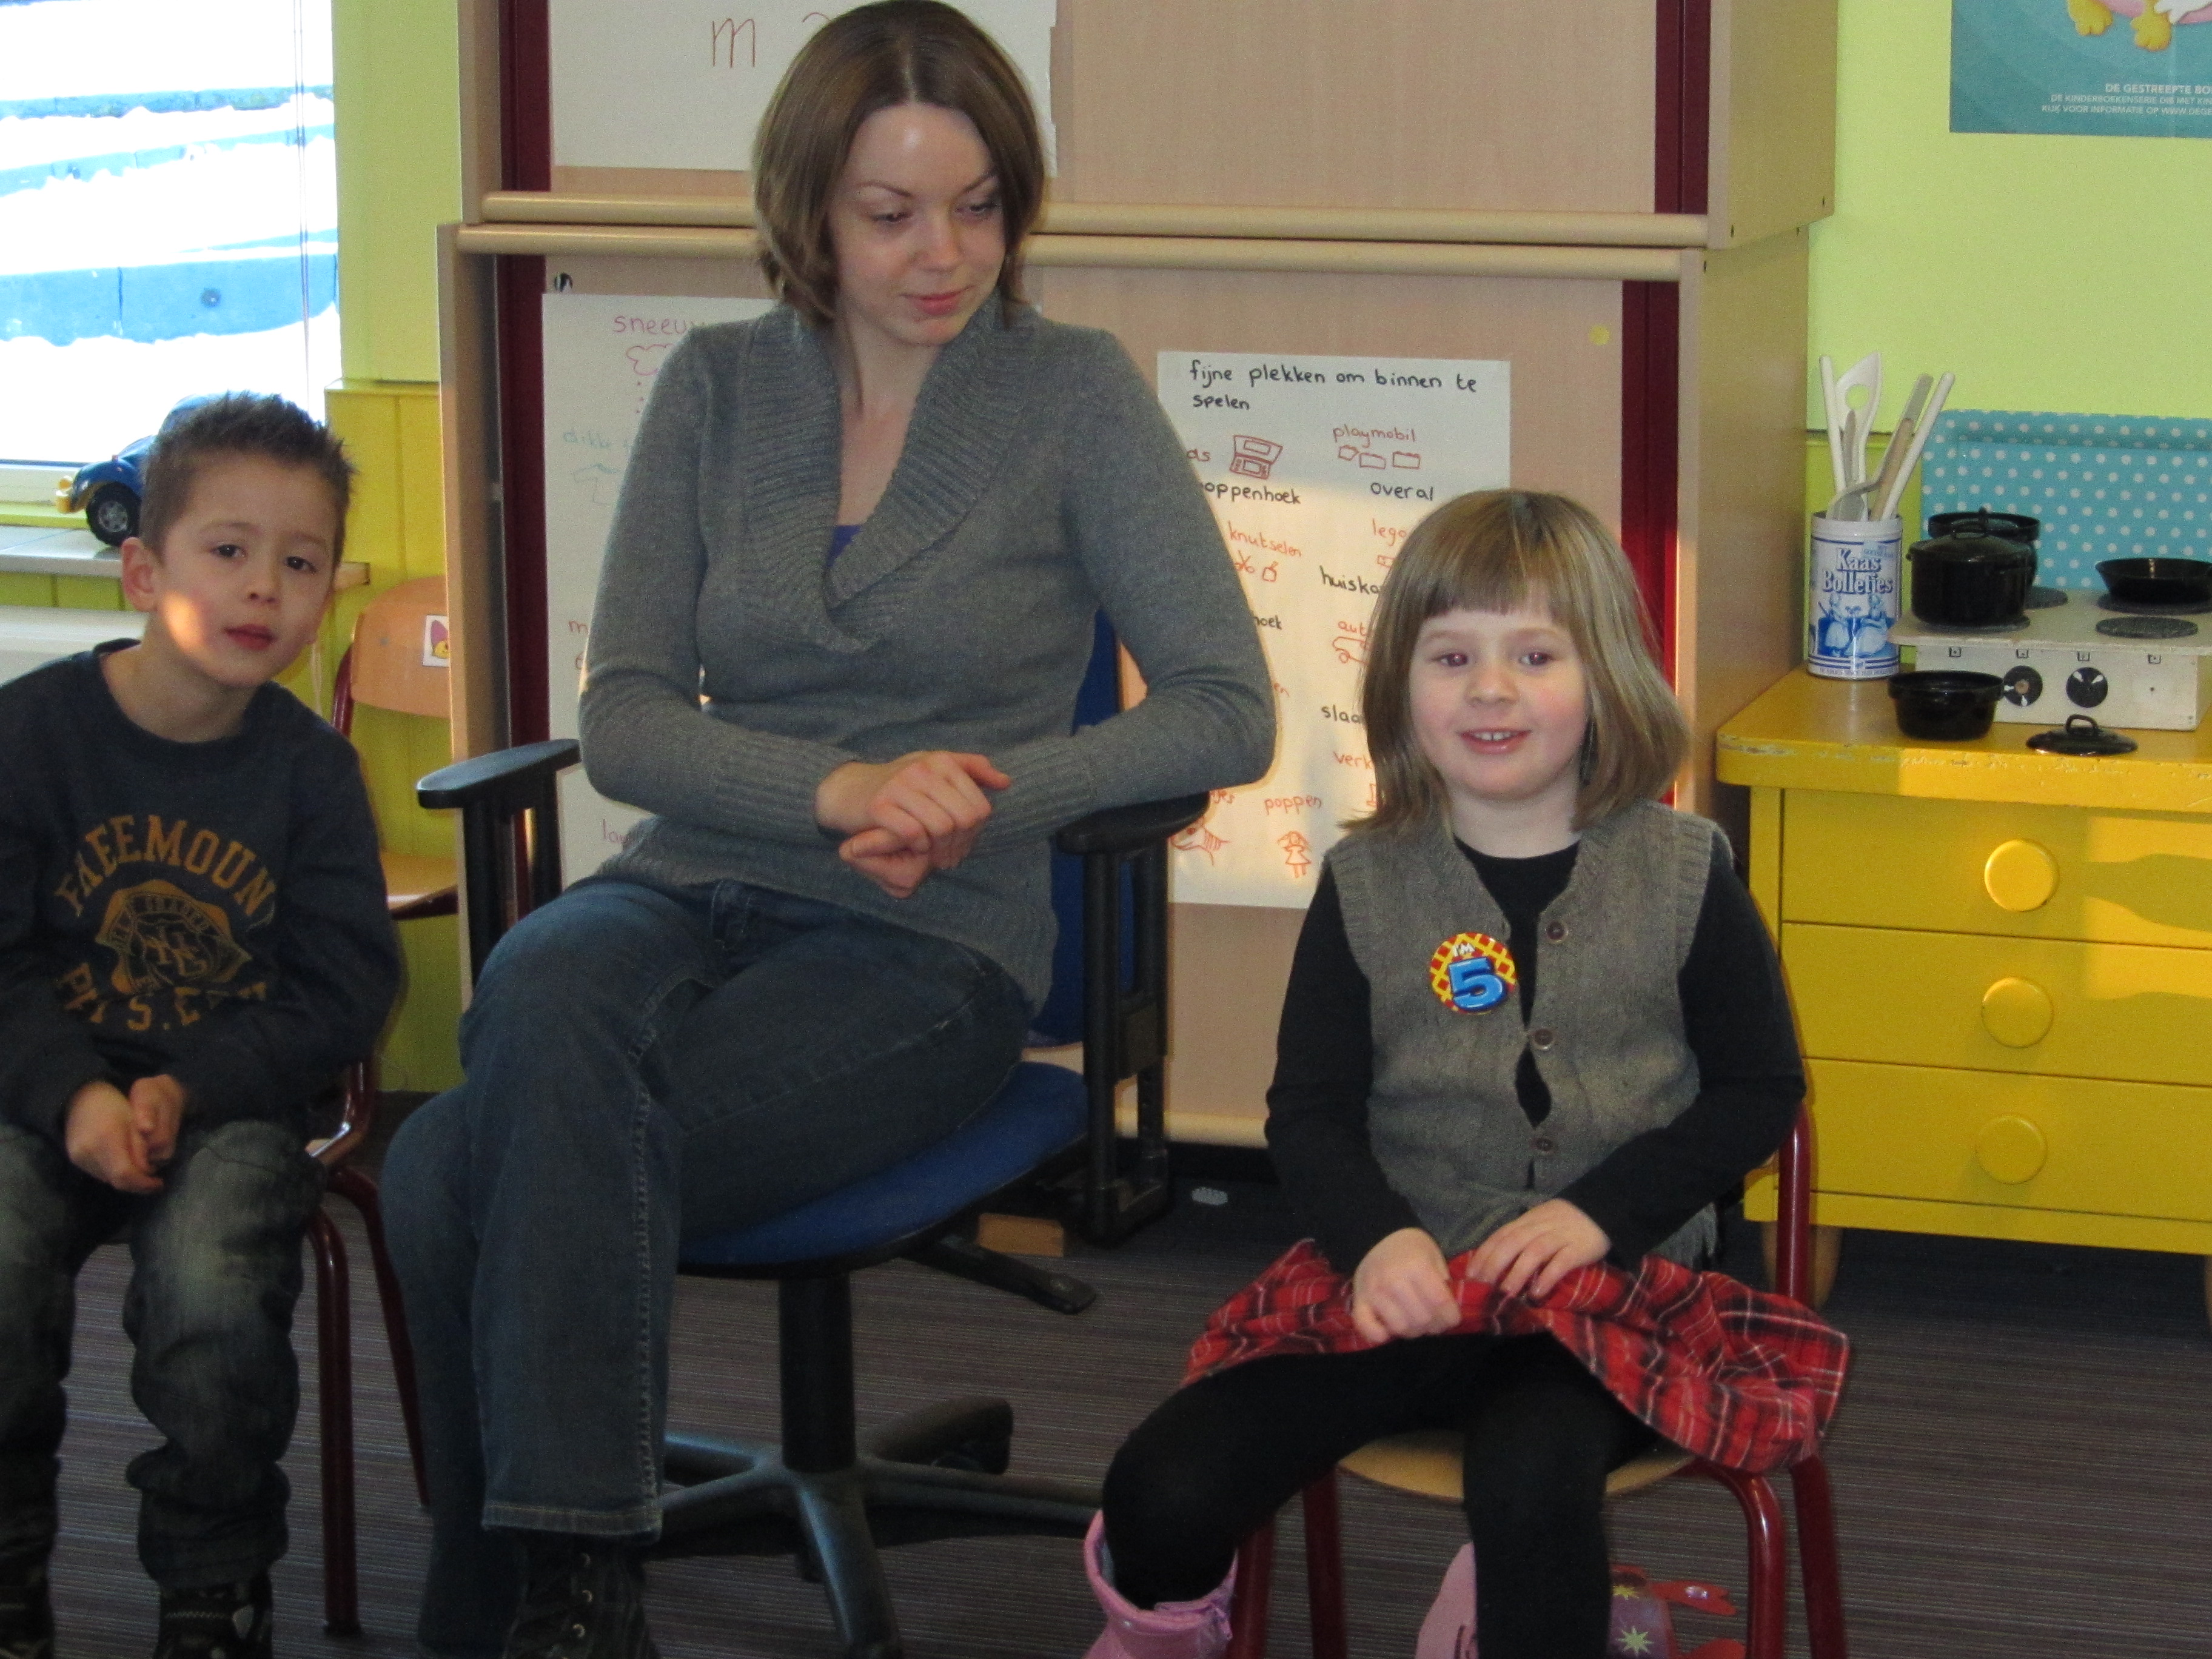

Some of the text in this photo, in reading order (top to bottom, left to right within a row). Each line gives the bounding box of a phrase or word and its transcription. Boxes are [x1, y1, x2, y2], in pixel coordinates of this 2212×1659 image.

[2105, 84, 2212, 95] DE GESTREEPTE BO
[613, 315, 705, 334] sneeu
[1190, 359, 1477, 392] fijne plekken om binnen te
[1193, 394, 1250, 411] spelen
[1333, 424, 1415, 448] playmobil
[1201, 482, 1301, 504] oppenhoek
[1228, 520, 1302, 557] knutselen
[1372, 518, 1407, 546] lego
[1836, 547, 1882, 572] Kaas
[1823, 570, 1894, 594] Bolletjes
[1338, 621, 1367, 637] aut
[1273, 683, 1290, 697] en
[1321, 704, 1362, 724] slaa
[1333, 751, 1375, 769] verk
[1264, 794, 1322, 816] poppen
[1448, 956, 1508, 1011] 5
